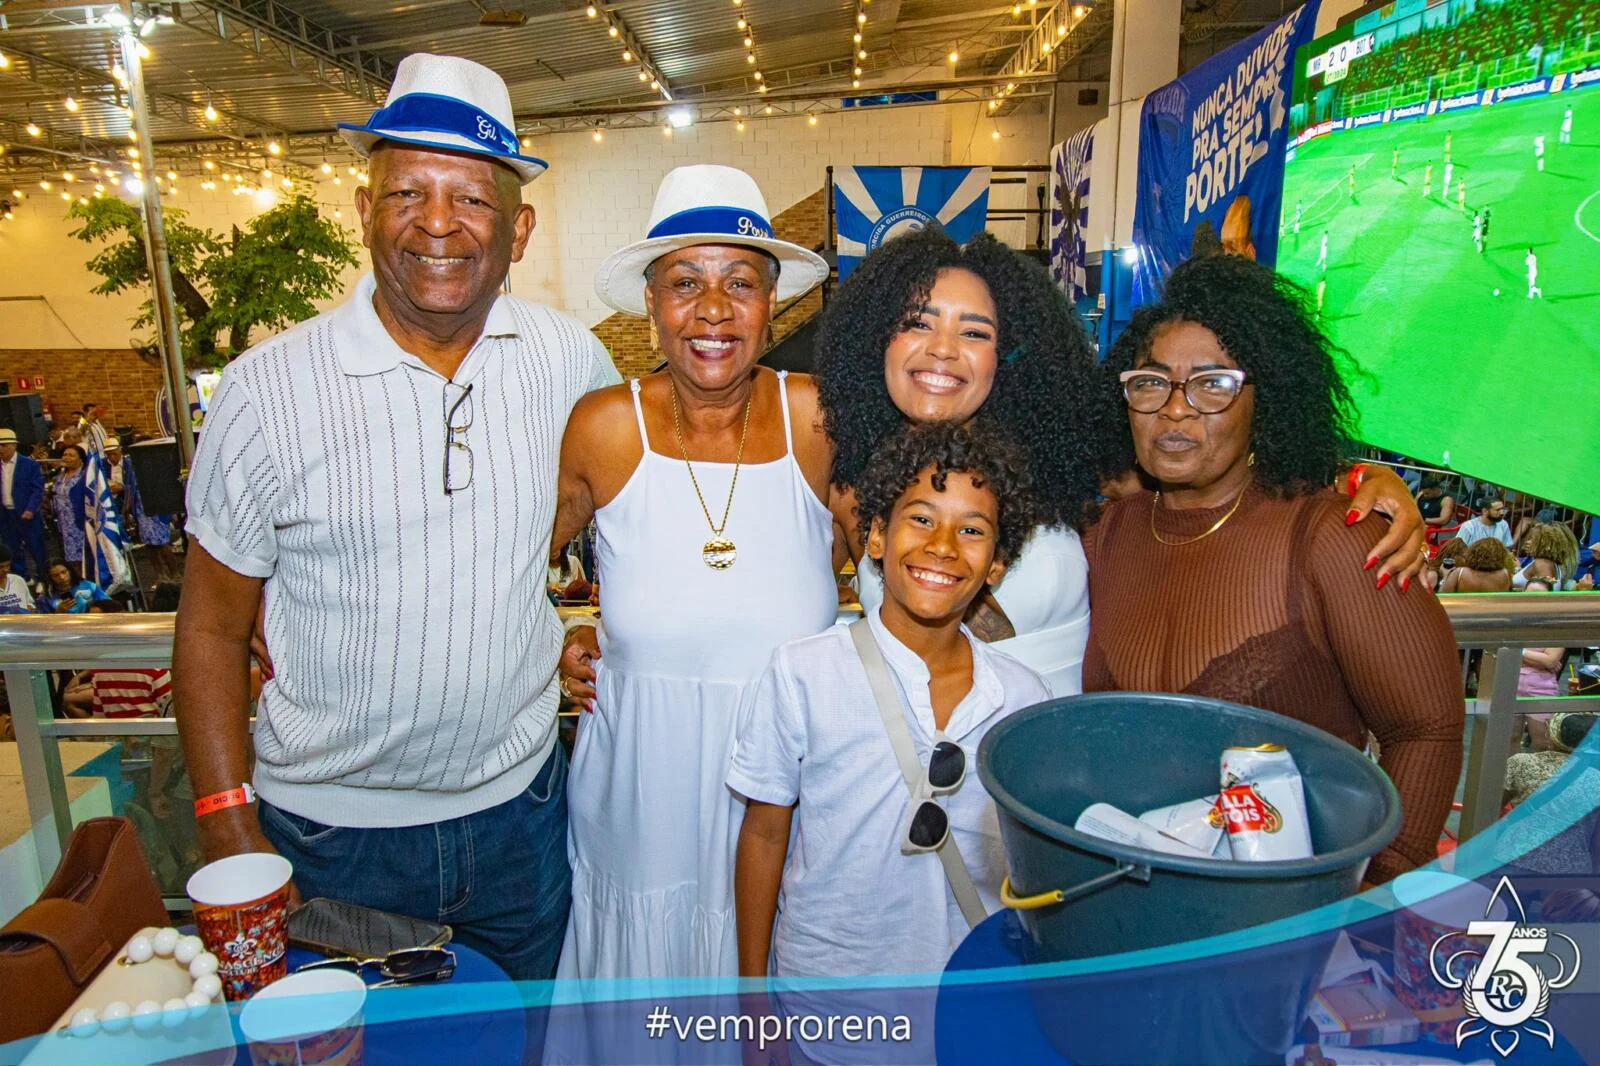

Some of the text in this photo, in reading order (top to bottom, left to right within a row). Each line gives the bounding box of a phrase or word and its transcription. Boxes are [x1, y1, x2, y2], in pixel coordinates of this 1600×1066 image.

[1328, 51, 1335, 67] 2
[1340, 46, 1347, 62] 0
[1192, 74, 1233, 138] NUNCA
[476, 115, 497, 140] Gil
[1192, 122, 1219, 170] PRA
